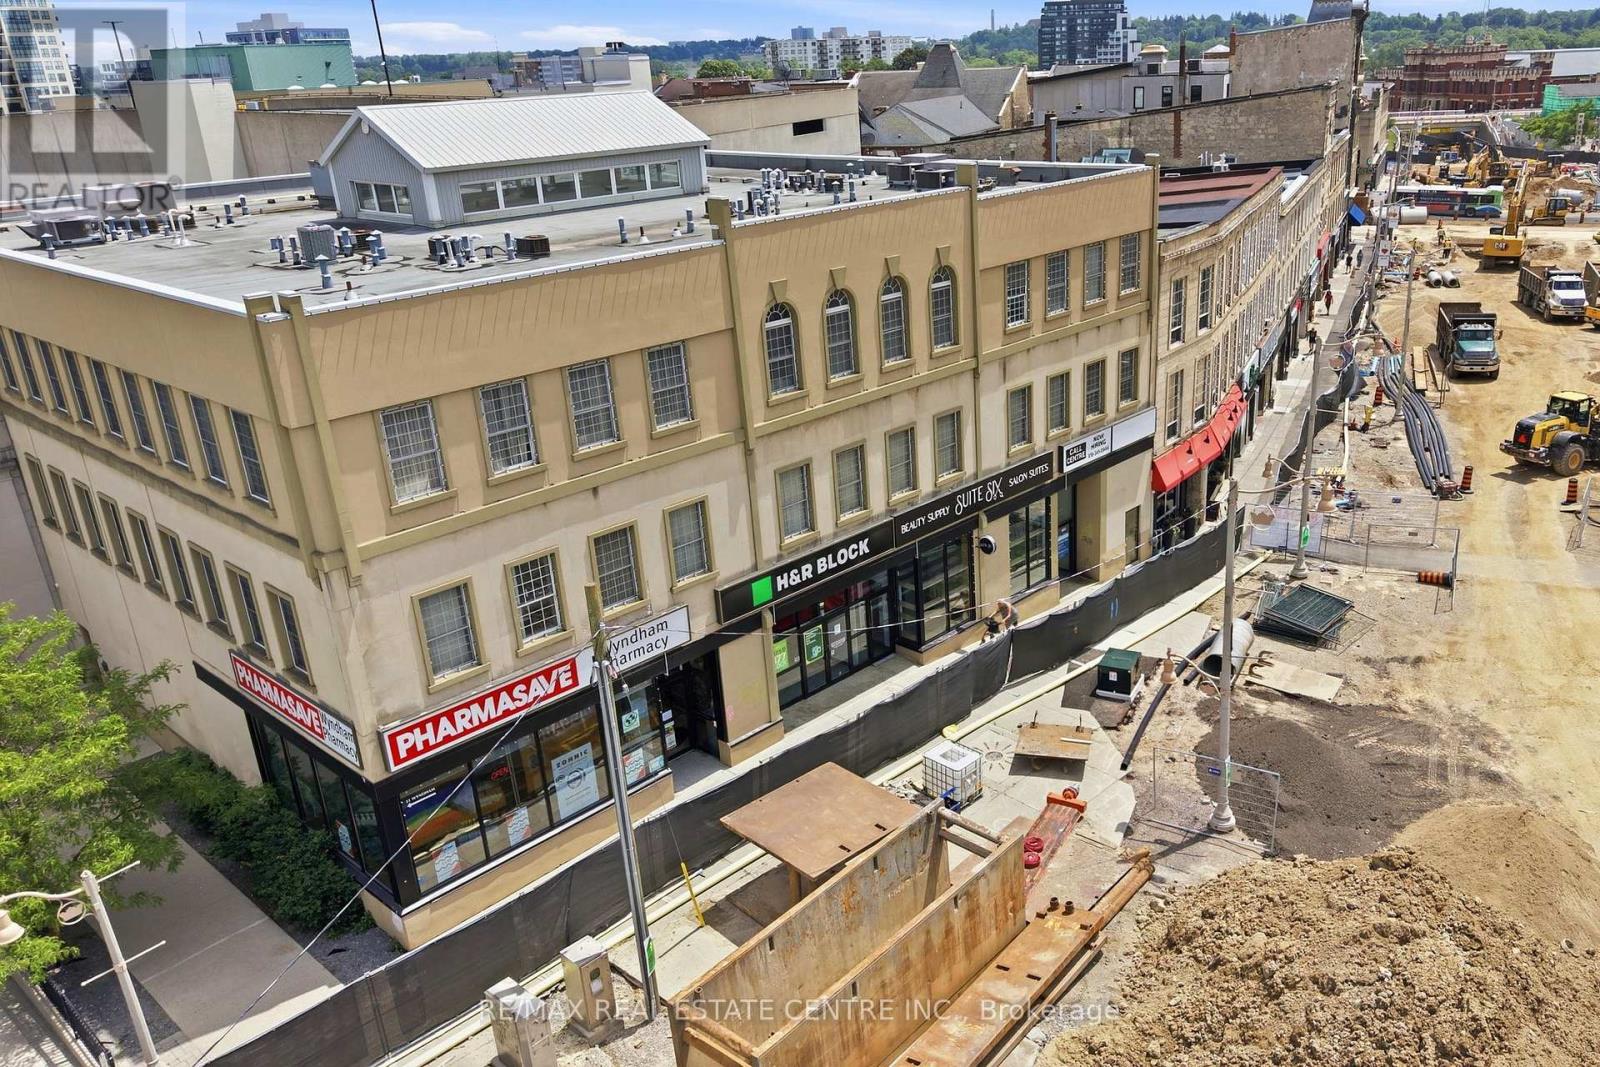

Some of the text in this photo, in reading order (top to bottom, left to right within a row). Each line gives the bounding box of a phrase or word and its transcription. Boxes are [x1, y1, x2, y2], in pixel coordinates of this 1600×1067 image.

[1066, 451, 1086, 465] CENTRE
[1069, 445, 1082, 455] CALL
[901, 463, 1049, 534] BEAUTY SUPPLY SUITE SIX SALON SUITES
[776, 538, 870, 592] H&R BLOCK
[608, 620, 668, 655] yndham
[611, 635, 669, 667] harmacy
[235, 661, 322, 735] PHARMASAVE
[395, 661, 574, 760] PHARMASAVE
[320, 711, 355, 742] Wyndham
[322, 726, 358, 763] Pharmacy
[555, 748, 589, 769] ZONNIC
